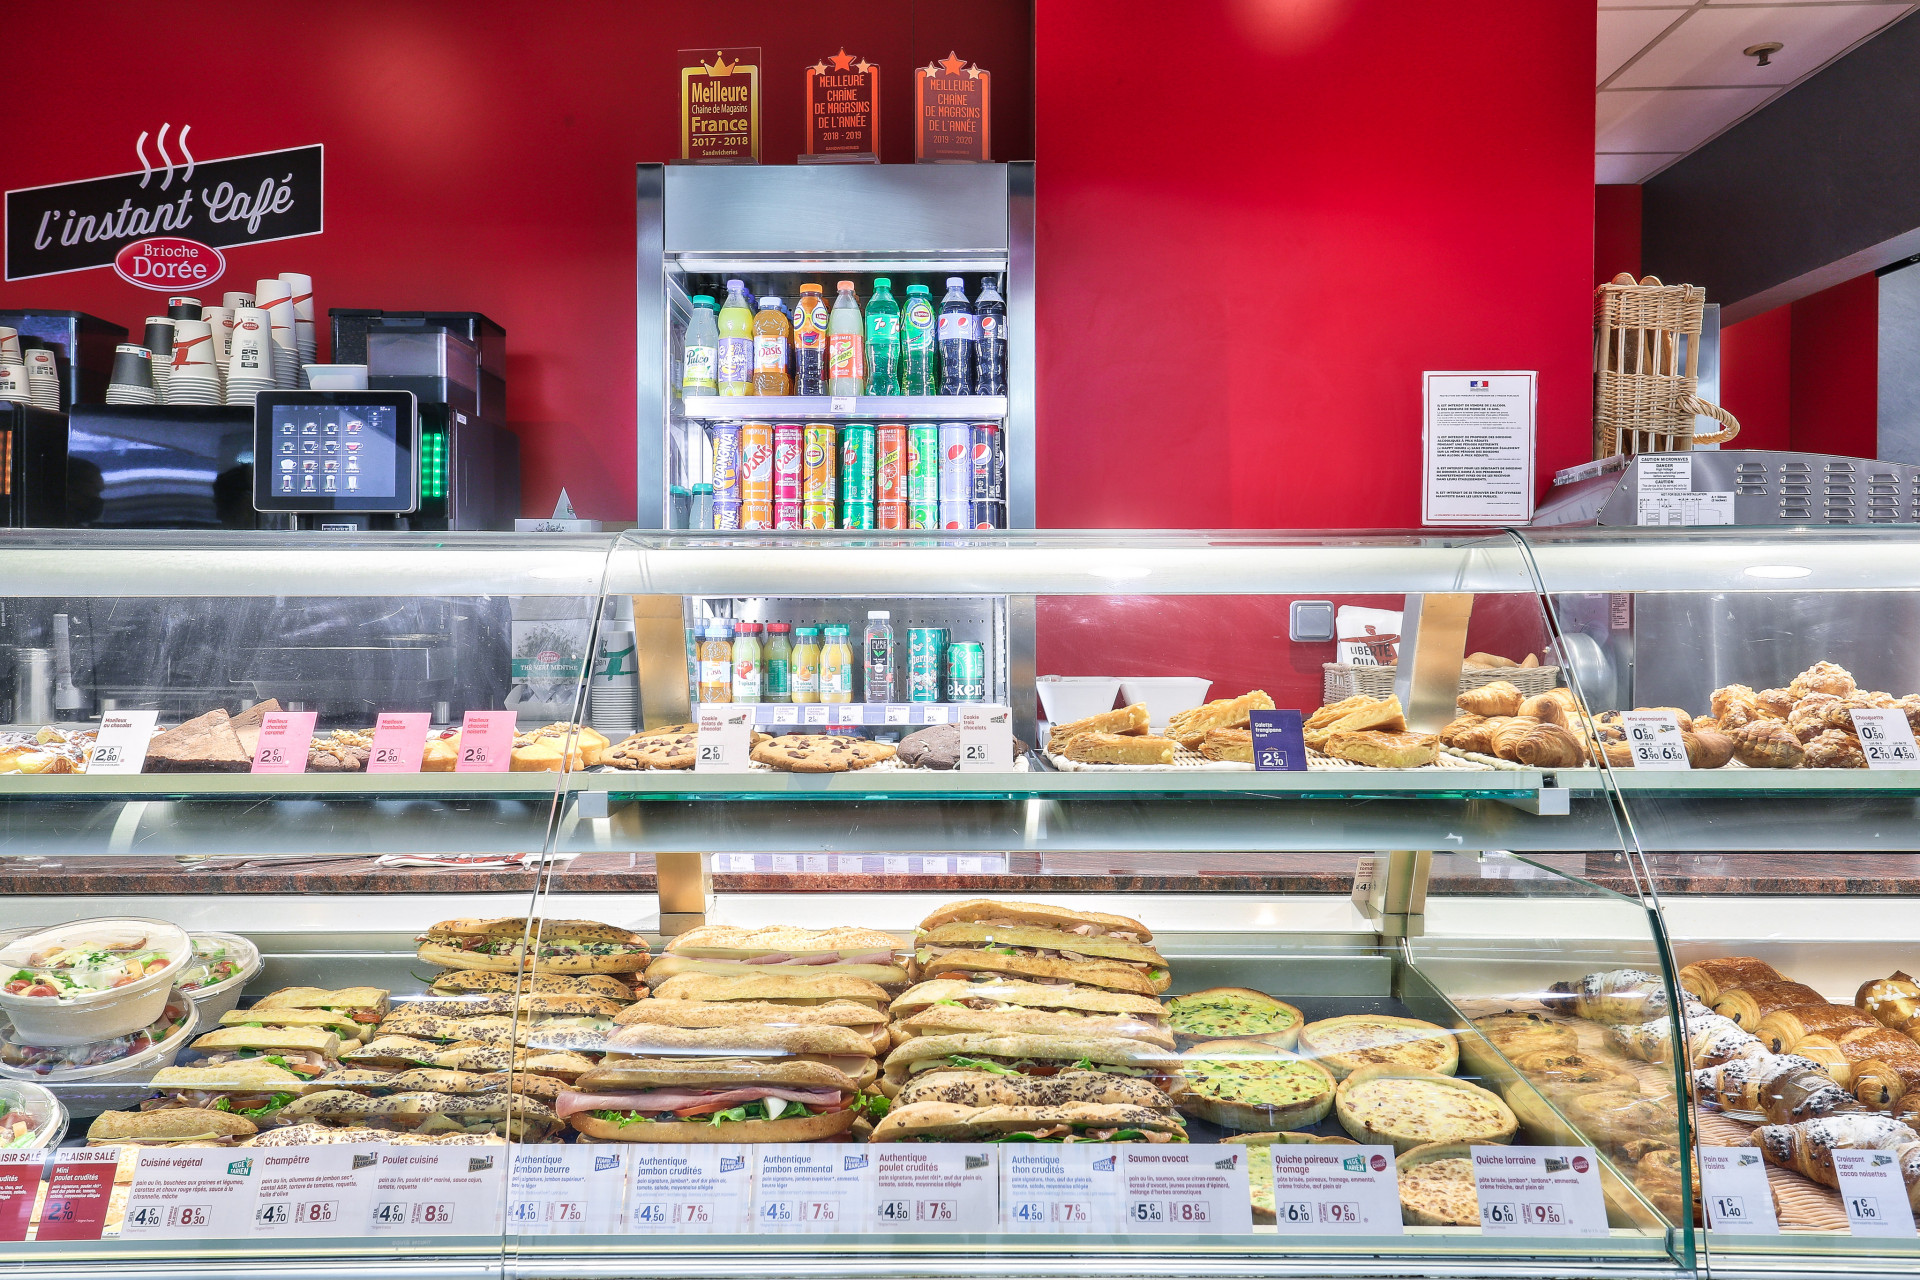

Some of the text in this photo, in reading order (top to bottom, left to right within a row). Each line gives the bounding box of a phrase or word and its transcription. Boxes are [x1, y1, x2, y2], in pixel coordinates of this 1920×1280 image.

[820, 75, 864, 87] MEILLEURE
[930, 80, 975, 91] MEILLEURE
[692, 81, 748, 102] Meilleure
[712, 104, 720, 113] de
[721, 104, 748, 115] Magasins
[815, 102, 870, 114] DE MAGASINS
[926, 106, 980, 118] DE MAGASINS
[692, 117, 748, 132] France
[819, 114, 866, 128] DE L'ANNÉE
[929, 119, 976, 132] DE L'ANNÉE
[823, 131, 862, 140] 2018 2019
[956, 136, 972, 144] 2020
[692, 137, 748, 146] 2017 2018
[35, 173, 295, 250] l'instant Café
[144, 243, 198, 258] Brioche
[132, 256, 207, 278] Dorée
[687, 349, 709, 365] Pulco
[743, 445, 773, 480] Oasis
[60, 1150, 115, 1161] PLAISIR SALÉ
[265, 1155, 310, 1166] Champêtre
[382, 1155, 439, 1164] Poulet cuisiné
[515, 1155, 562, 1165] Authentique
[764, 1155, 811, 1165] Authentique
[879, 1153, 927, 1163] Authentique
[1012, 1155, 1060, 1165] Authentique
[1128, 1154, 1189, 1163] Saumon avocat
[1275, 1155, 1339, 1165] Quiche poireaux
[1476, 1156, 1536, 1165] Quiche lorraine
[141, 1158, 203, 1168] Cuisiné végétal
[639, 1157, 687, 1167] Authentique
[544, 1166, 570, 1174] beurre
[638, 1166, 702, 1177] jambon crudités
[762, 1164, 833, 1174] jambon emmental
[879, 1163, 938, 1173] poulet crudités
[1012, 1165, 1064, 1174] thon crudités
[1276, 1165, 1309, 1175] fromage
[54, 1174, 73, 1182] poulet
